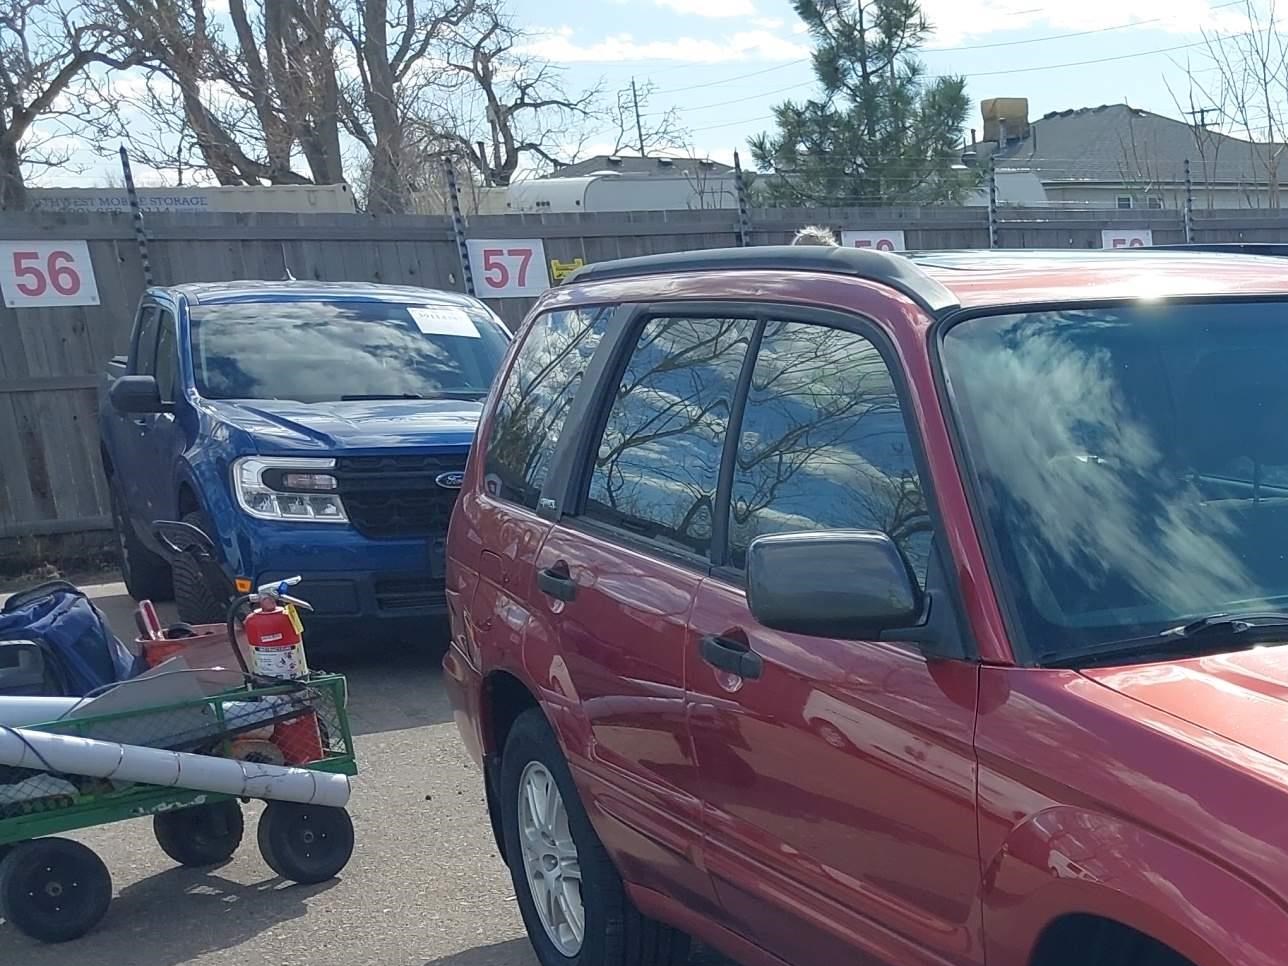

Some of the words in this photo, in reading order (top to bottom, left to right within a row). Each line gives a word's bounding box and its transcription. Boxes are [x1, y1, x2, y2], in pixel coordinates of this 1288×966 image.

[150, 197, 208, 207] STORAGE
[13, 251, 80, 296] 56
[484, 249, 532, 288] 57
